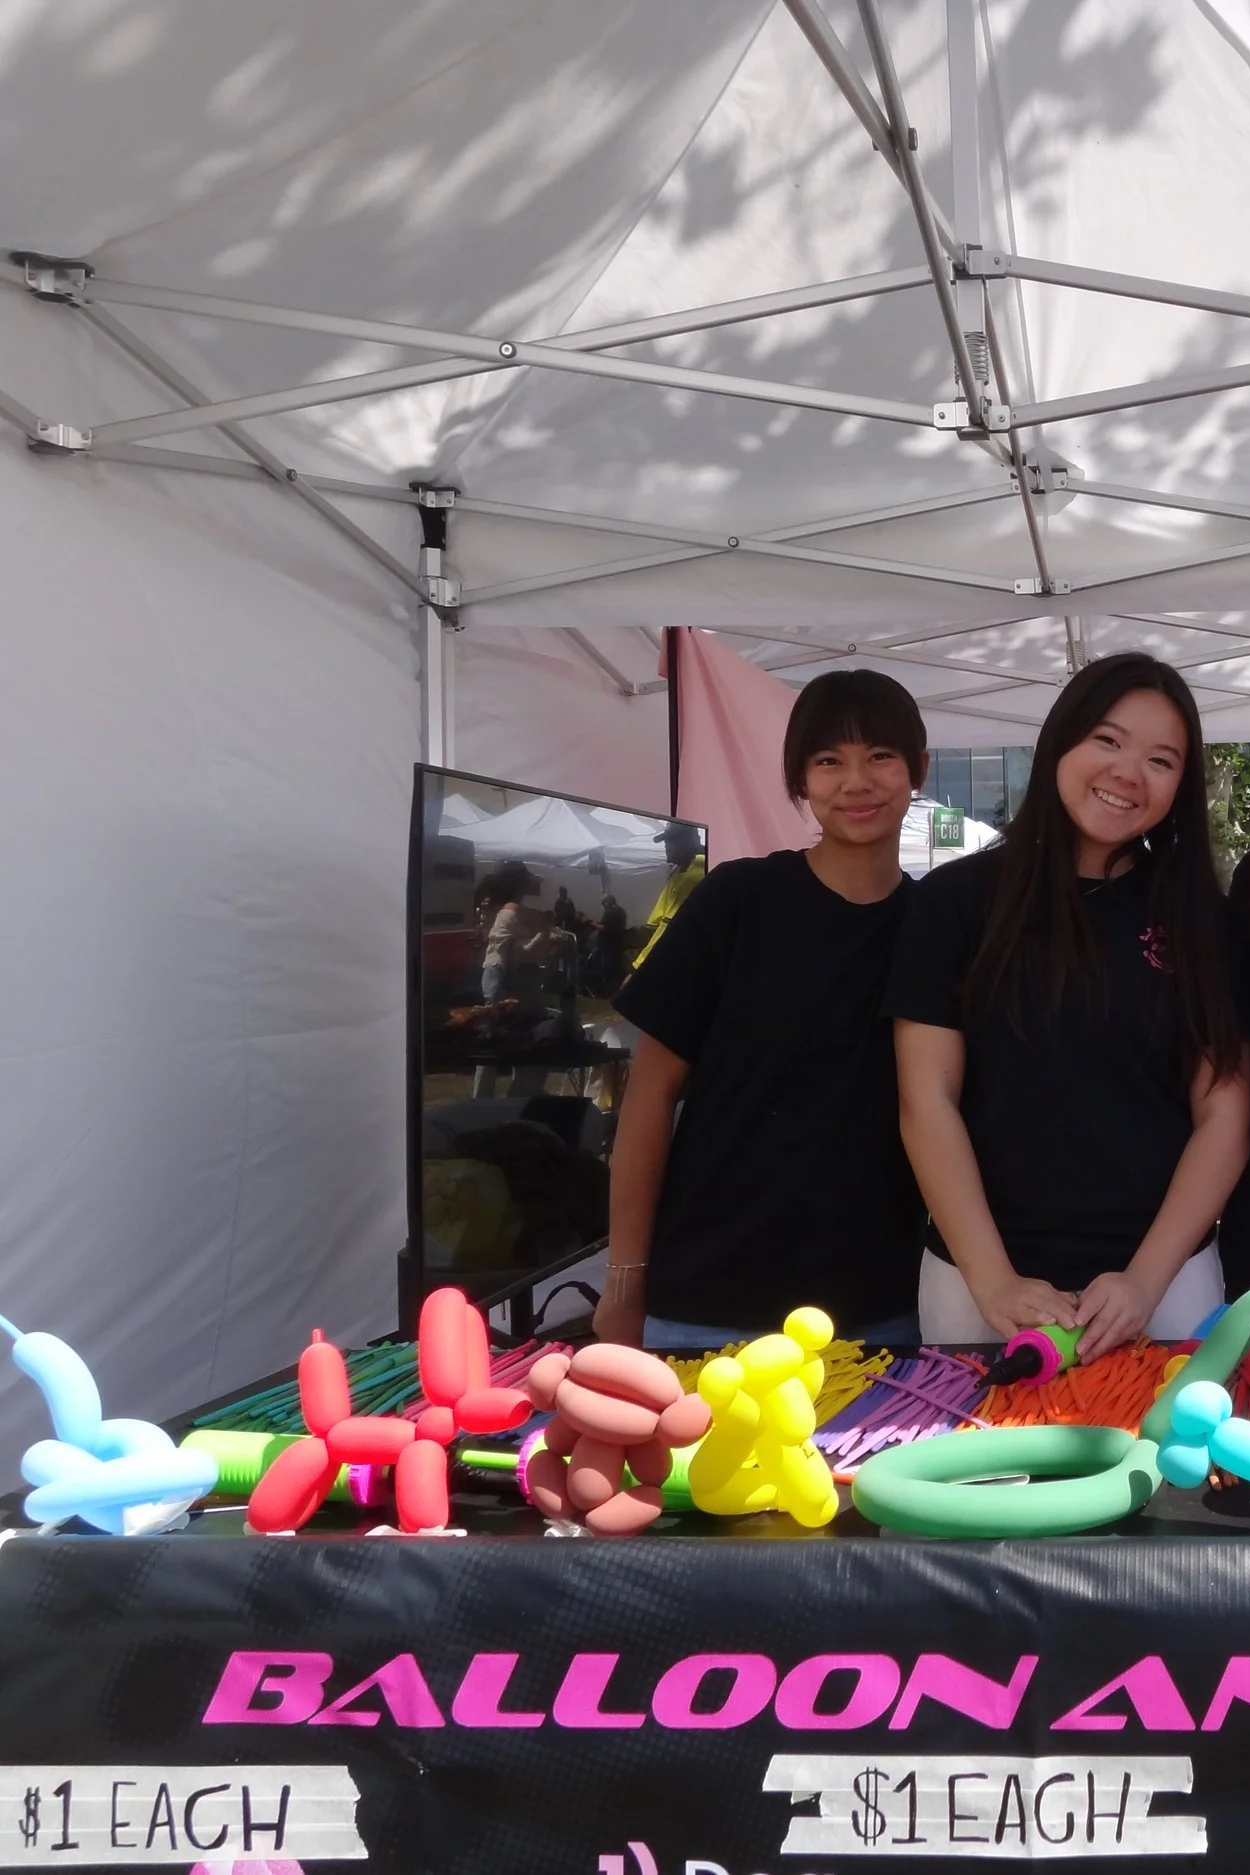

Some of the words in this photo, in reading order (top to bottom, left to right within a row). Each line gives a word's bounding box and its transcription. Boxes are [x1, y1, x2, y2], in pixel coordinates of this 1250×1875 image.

[940, 823, 959, 840] C18
[201, 1651, 1039, 1730] BALLOON
[18, 1779, 80, 1849] $1
[110, 1780, 292, 1852] EACH
[852, 1766, 927, 1847] $1
[948, 1770, 1132, 1845] EACH
